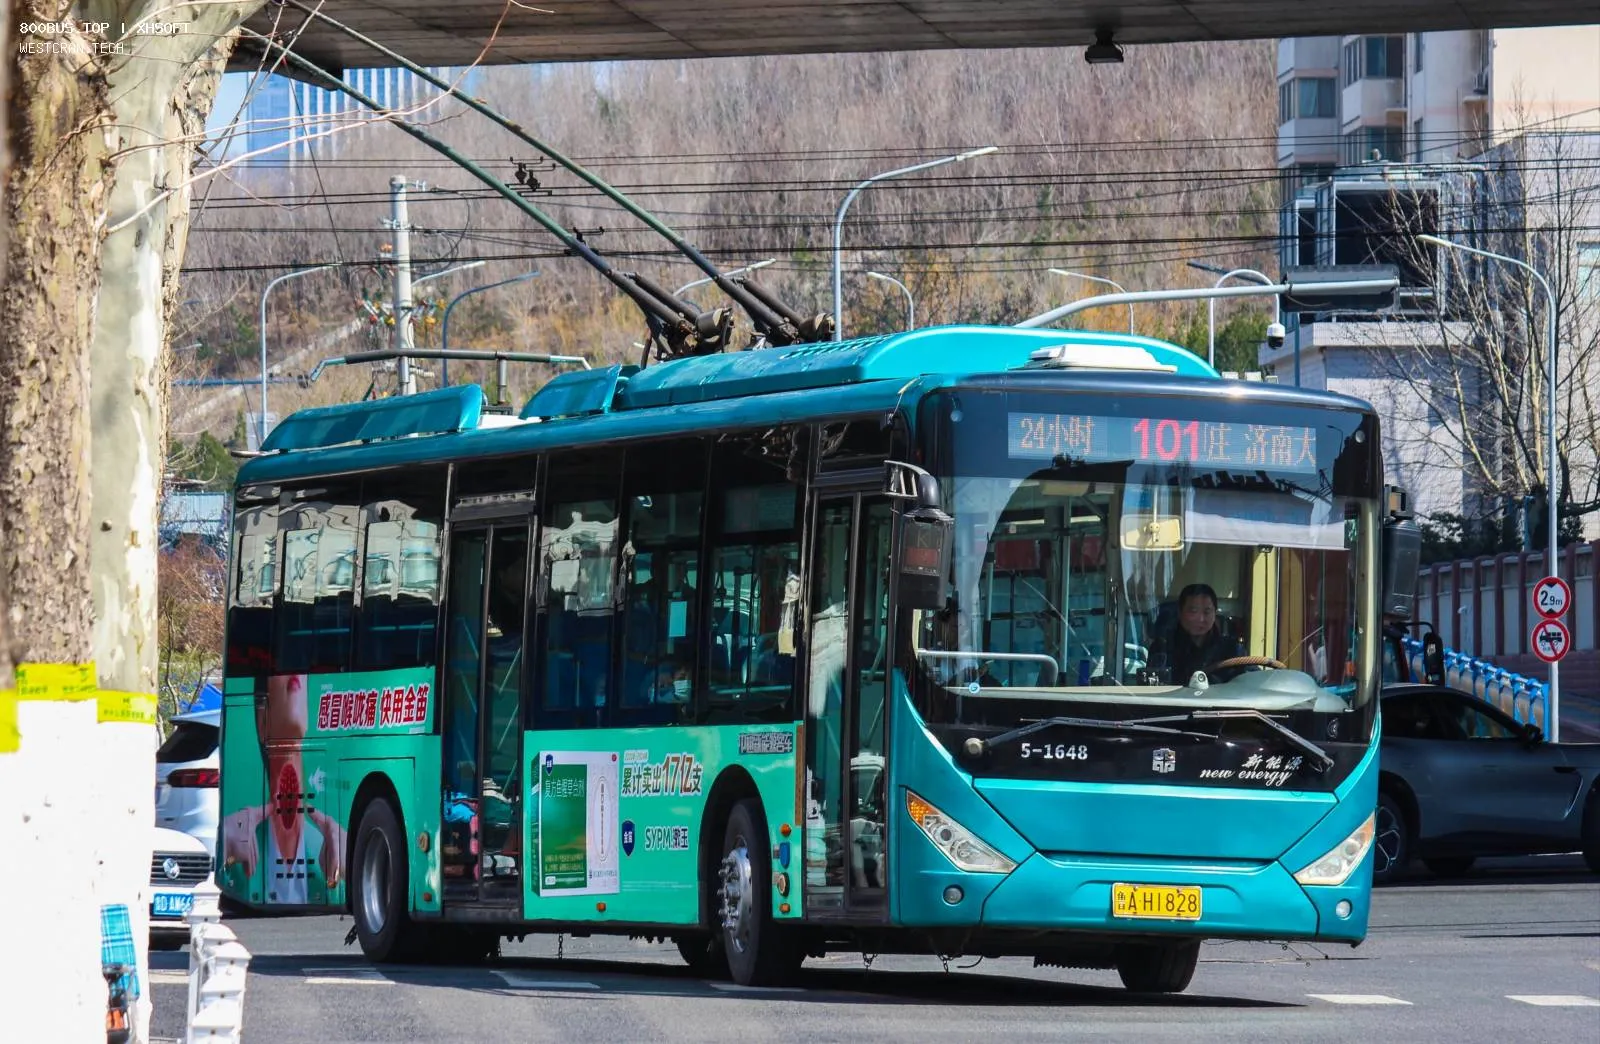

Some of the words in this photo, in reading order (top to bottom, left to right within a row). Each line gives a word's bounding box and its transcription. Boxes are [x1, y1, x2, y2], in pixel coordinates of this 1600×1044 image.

[1133, 417, 1200, 462] 101
[1020, 743, 1089, 760] 5-1648
[1199, 769, 1236, 780] new
[1238, 769, 1293, 787] energy
